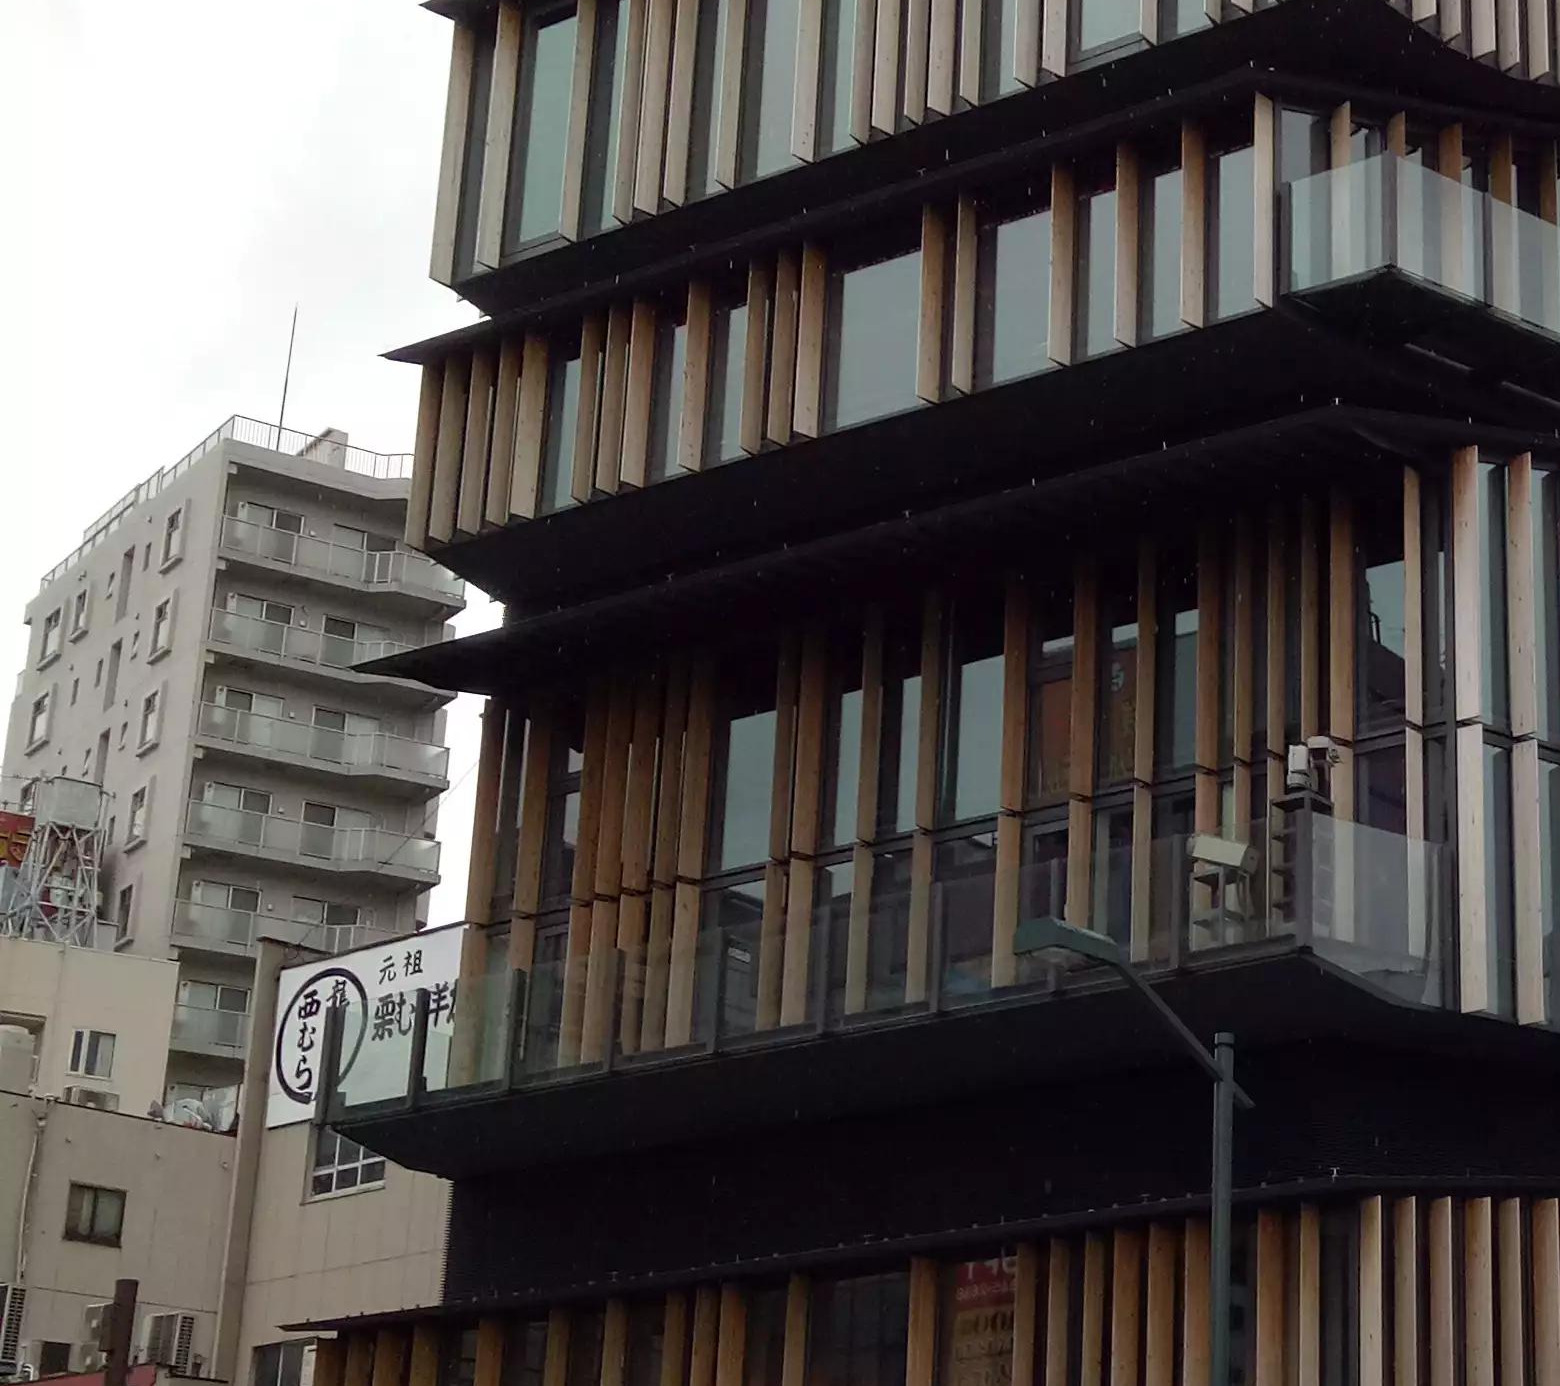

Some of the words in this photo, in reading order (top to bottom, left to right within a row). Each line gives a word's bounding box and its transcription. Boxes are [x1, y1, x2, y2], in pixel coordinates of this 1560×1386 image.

[378, 949, 425, 985] 元祖
[294, 988, 322, 1091] 西むら
